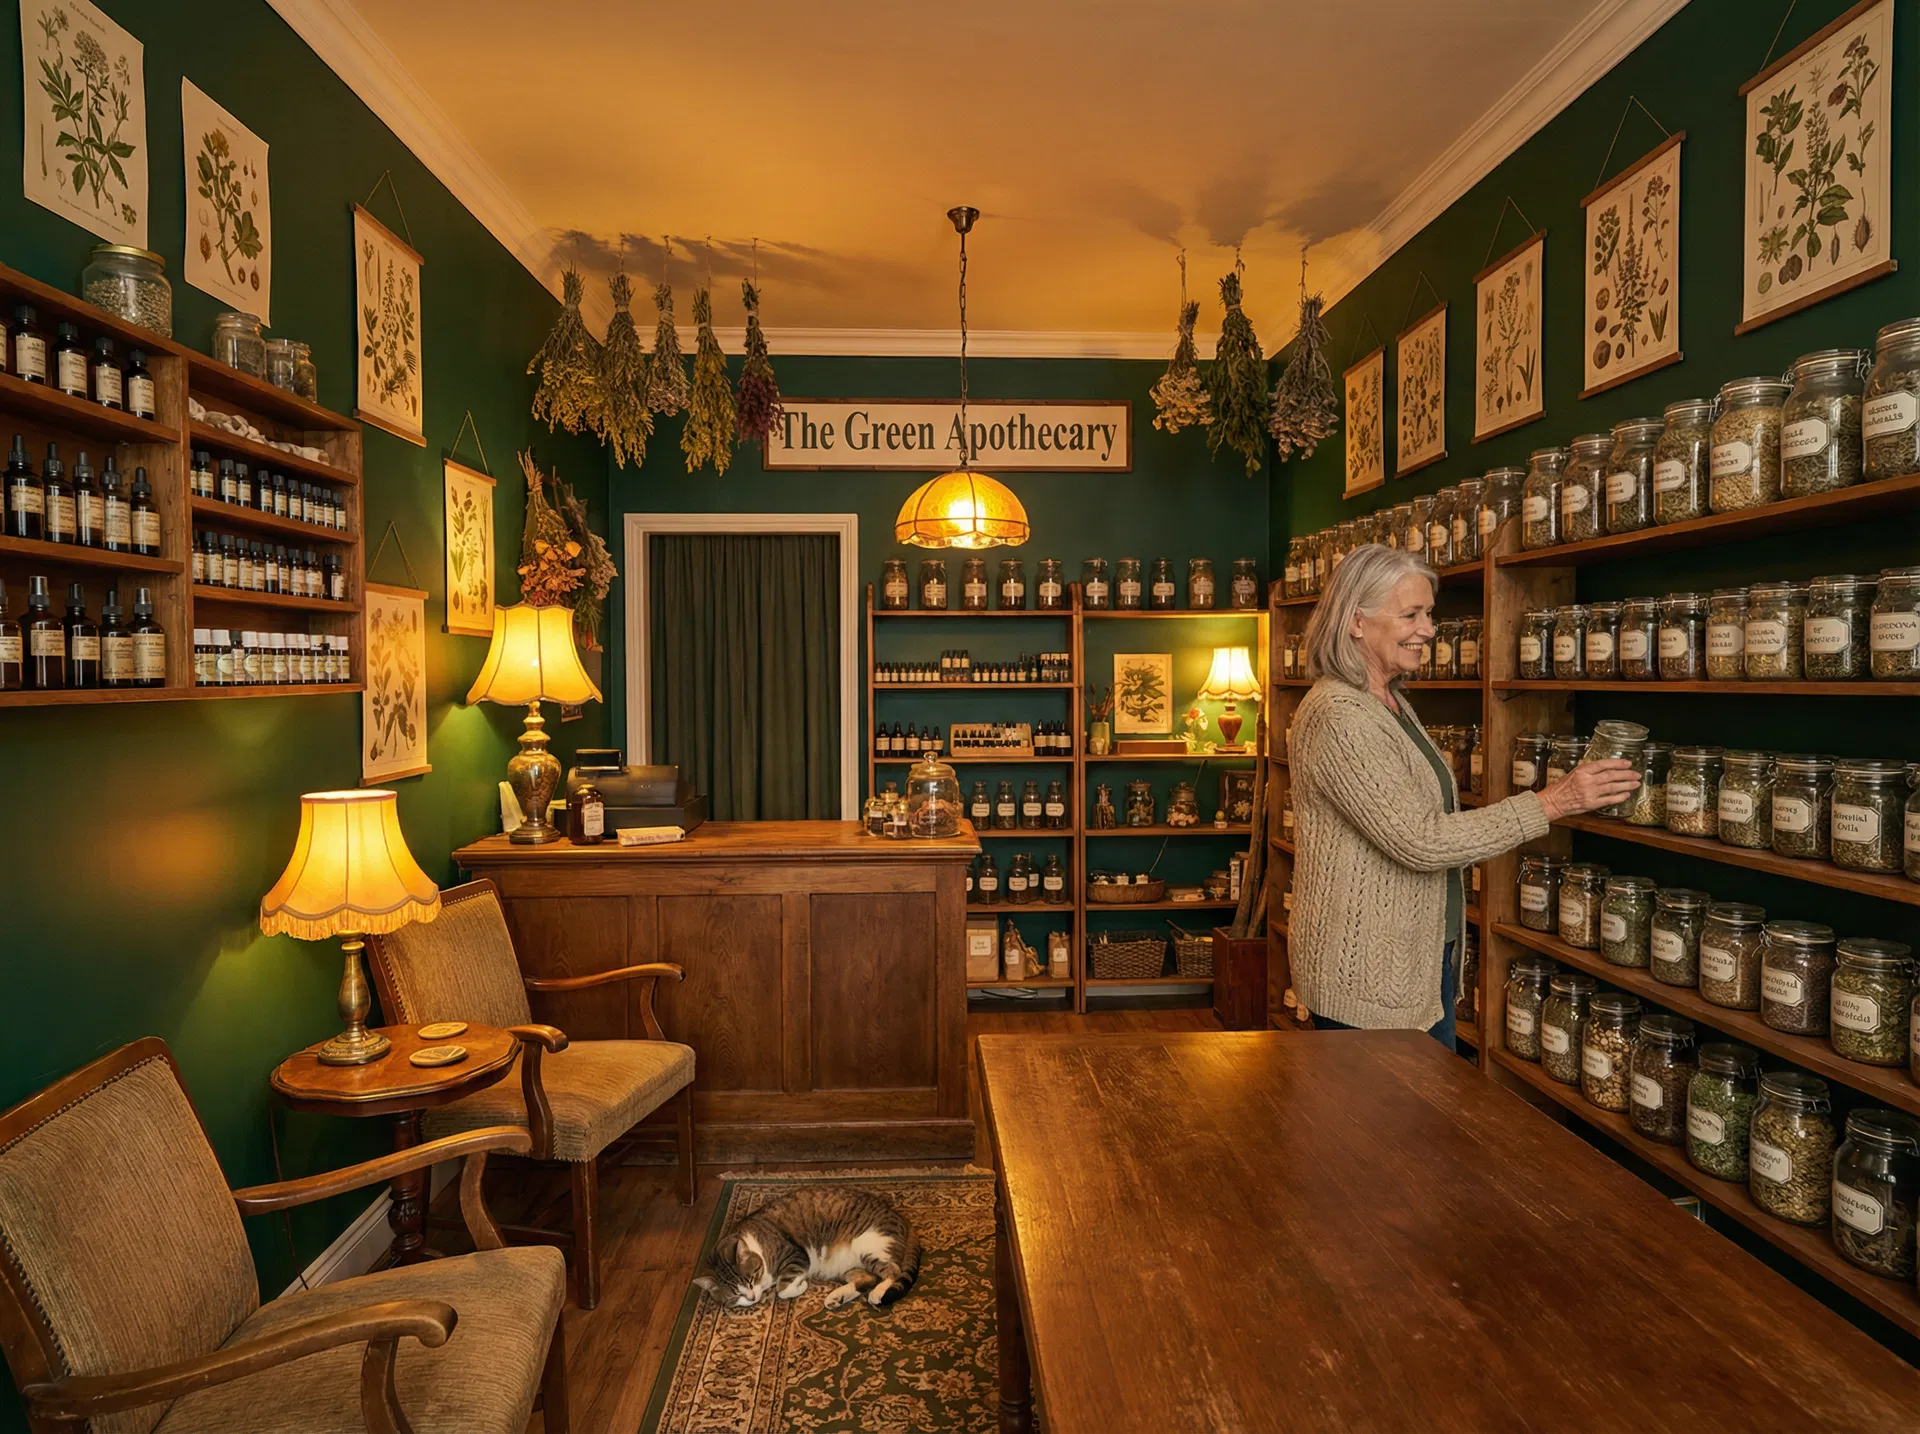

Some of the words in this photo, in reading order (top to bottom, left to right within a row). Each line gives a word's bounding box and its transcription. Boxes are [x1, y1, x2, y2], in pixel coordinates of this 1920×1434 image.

[782, 411, 835, 451] The
[844, 411, 935, 451] Green
[945, 411, 1117, 462] Apothecary
